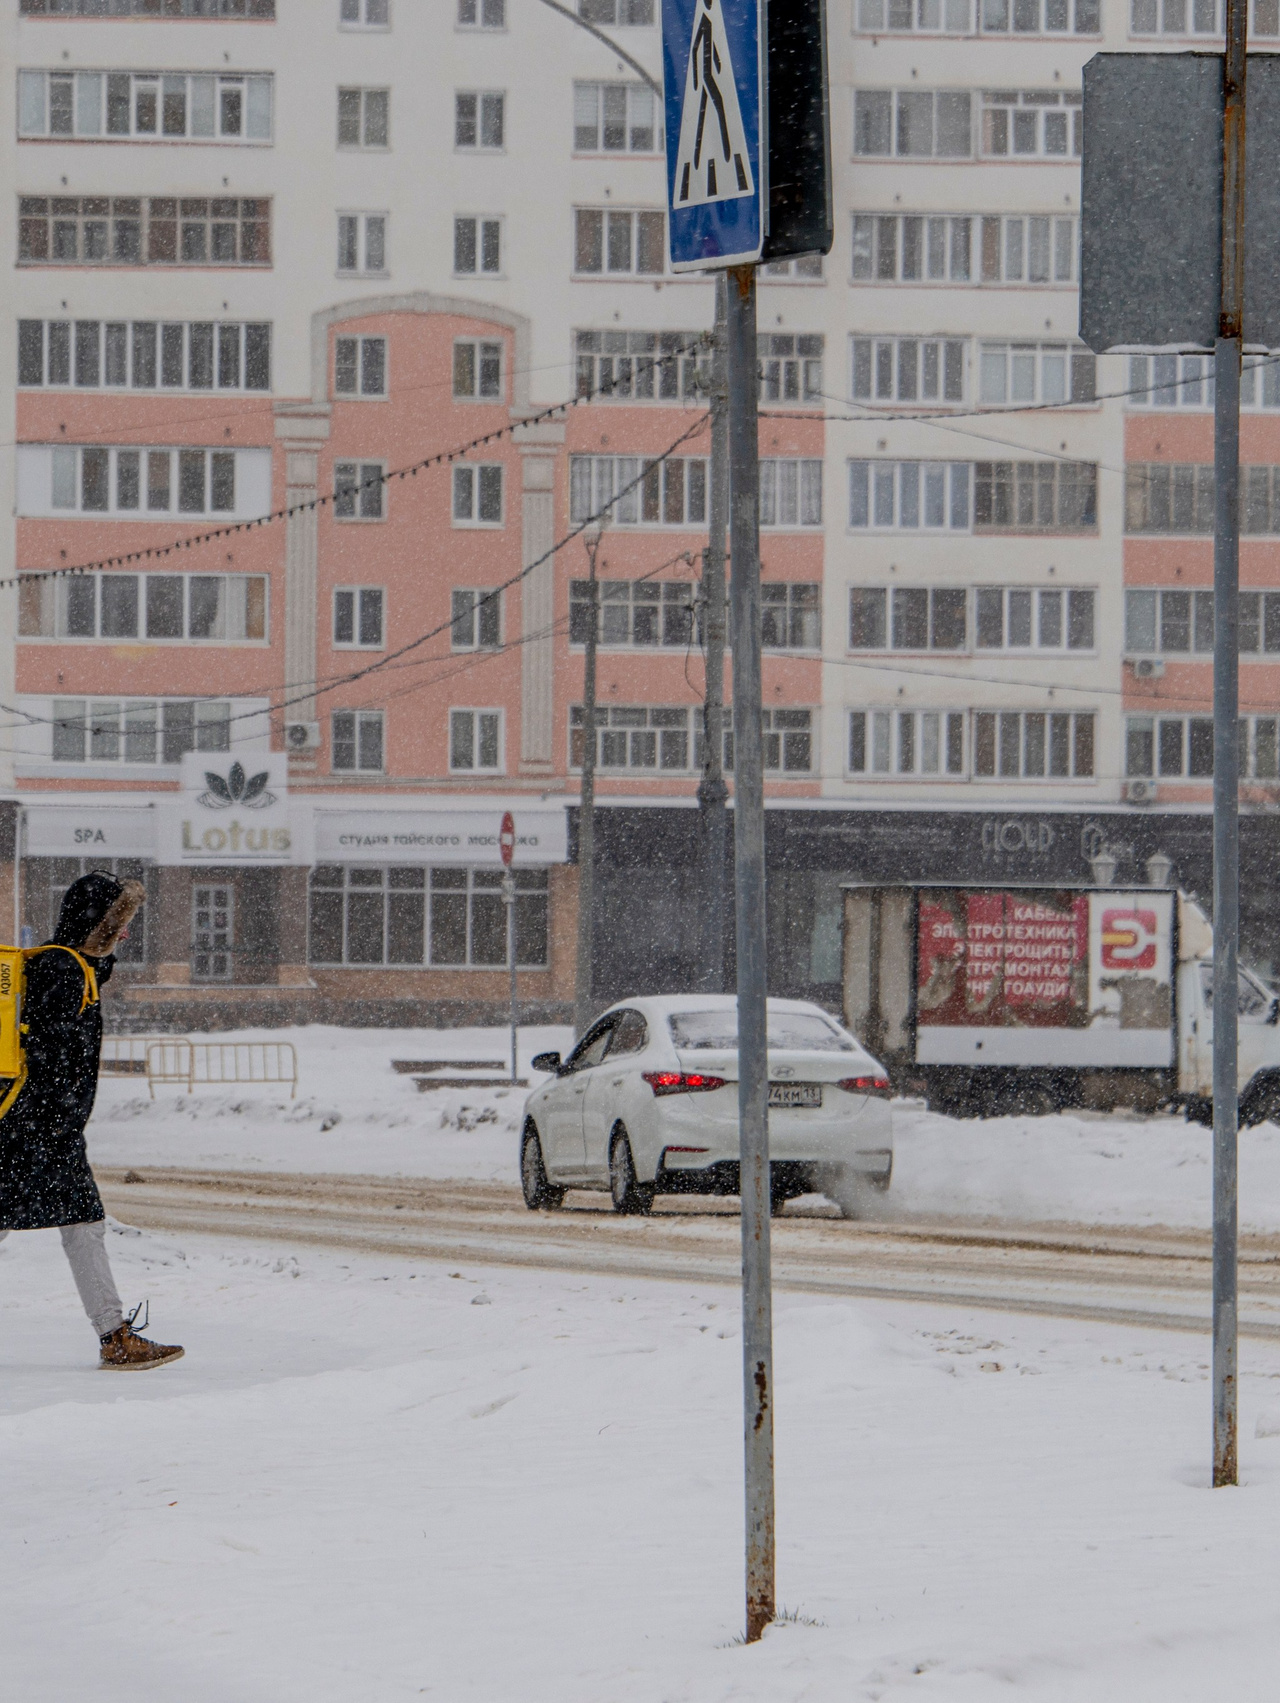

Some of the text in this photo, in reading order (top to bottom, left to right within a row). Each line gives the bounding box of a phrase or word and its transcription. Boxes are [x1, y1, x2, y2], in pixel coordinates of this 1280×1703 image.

[73, 828, 106, 844] SPA
[181, 819, 291, 851] Lotus
[338, 833, 539, 848] студия тайского масжа
[931, 923, 1078, 941] ЭЛТРОТЕХНИКА
[0, 963, 12, 996] AQ3057
